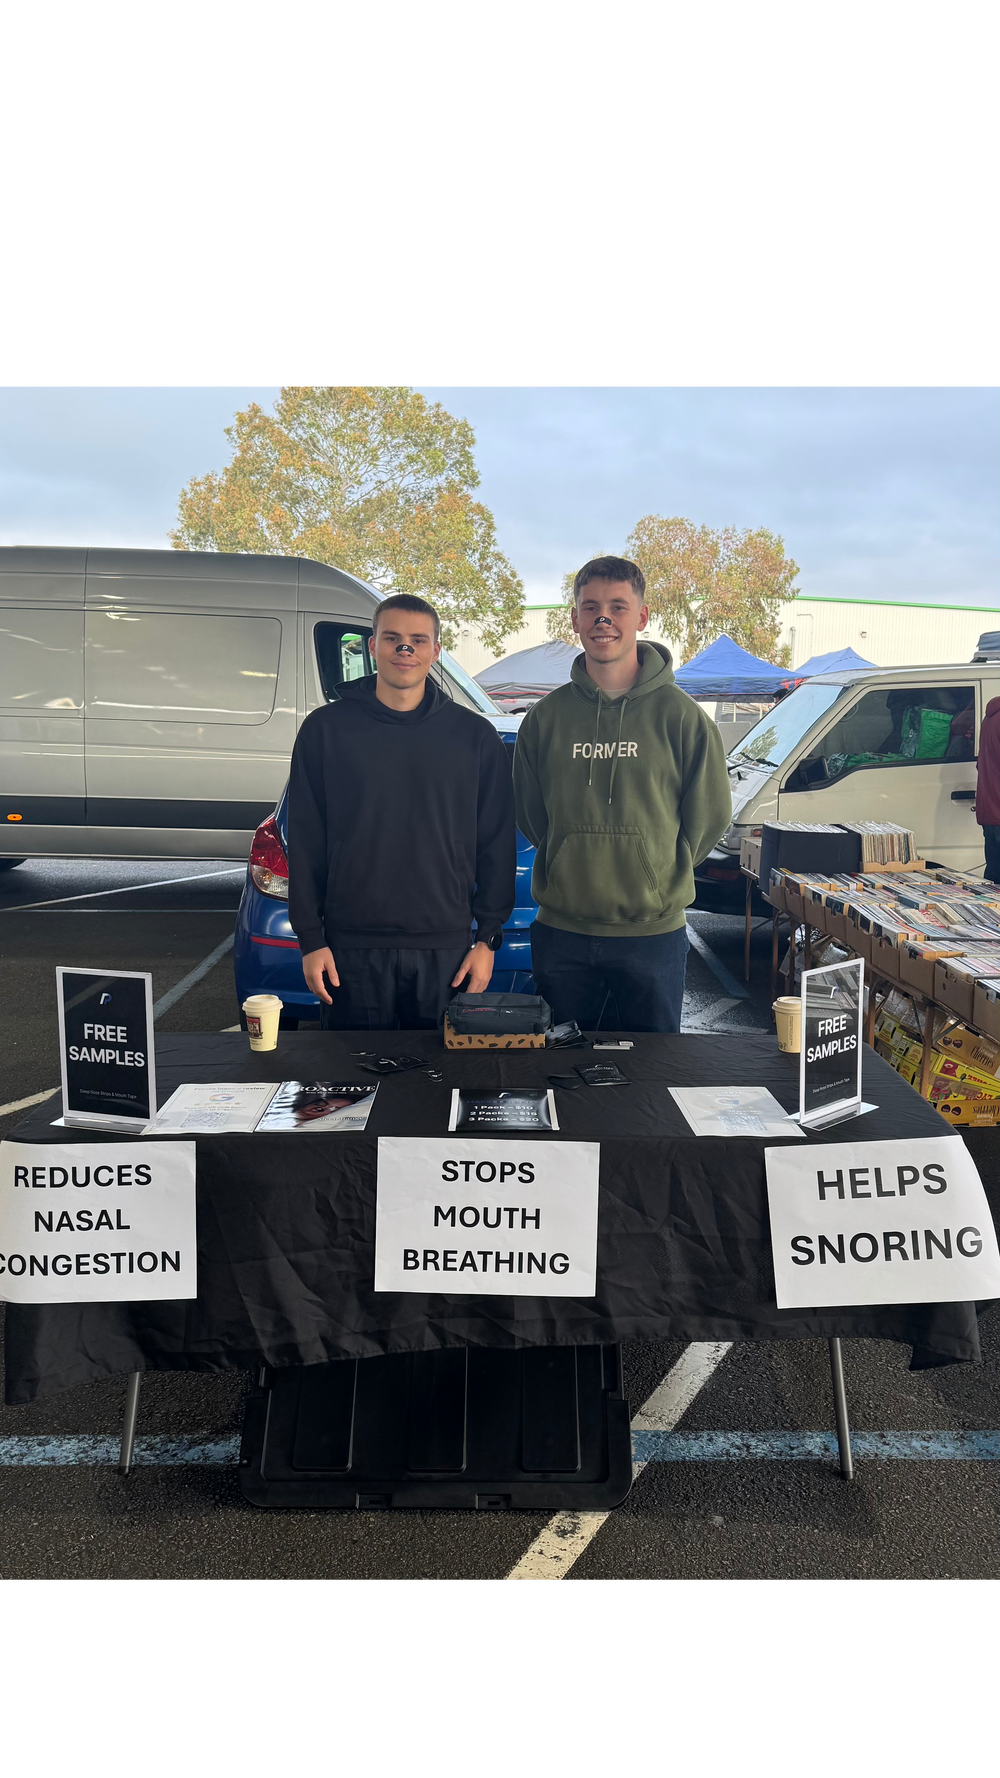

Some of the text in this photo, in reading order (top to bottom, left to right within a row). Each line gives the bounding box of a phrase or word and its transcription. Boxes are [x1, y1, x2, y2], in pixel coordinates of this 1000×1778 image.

[572, 741, 638, 759] FORMER
[83, 1023, 128, 1043] FREE
[818, 1014, 847, 1038] FREE
[69, 1046, 145, 1067] SAMPLES
[806, 1034, 857, 1063] SAMPLES
[14, 1164, 152, 1188] REDUCES
[441, 1160, 535, 1184] STOPS
[816, 1163, 948, 1200] HELPS
[34, 1208, 131, 1232] NASAL
[433, 1205, 541, 1229] MOUTH
[790, 1226, 983, 1266] SNORING
[403, 1248, 570, 1275] BREATHING
